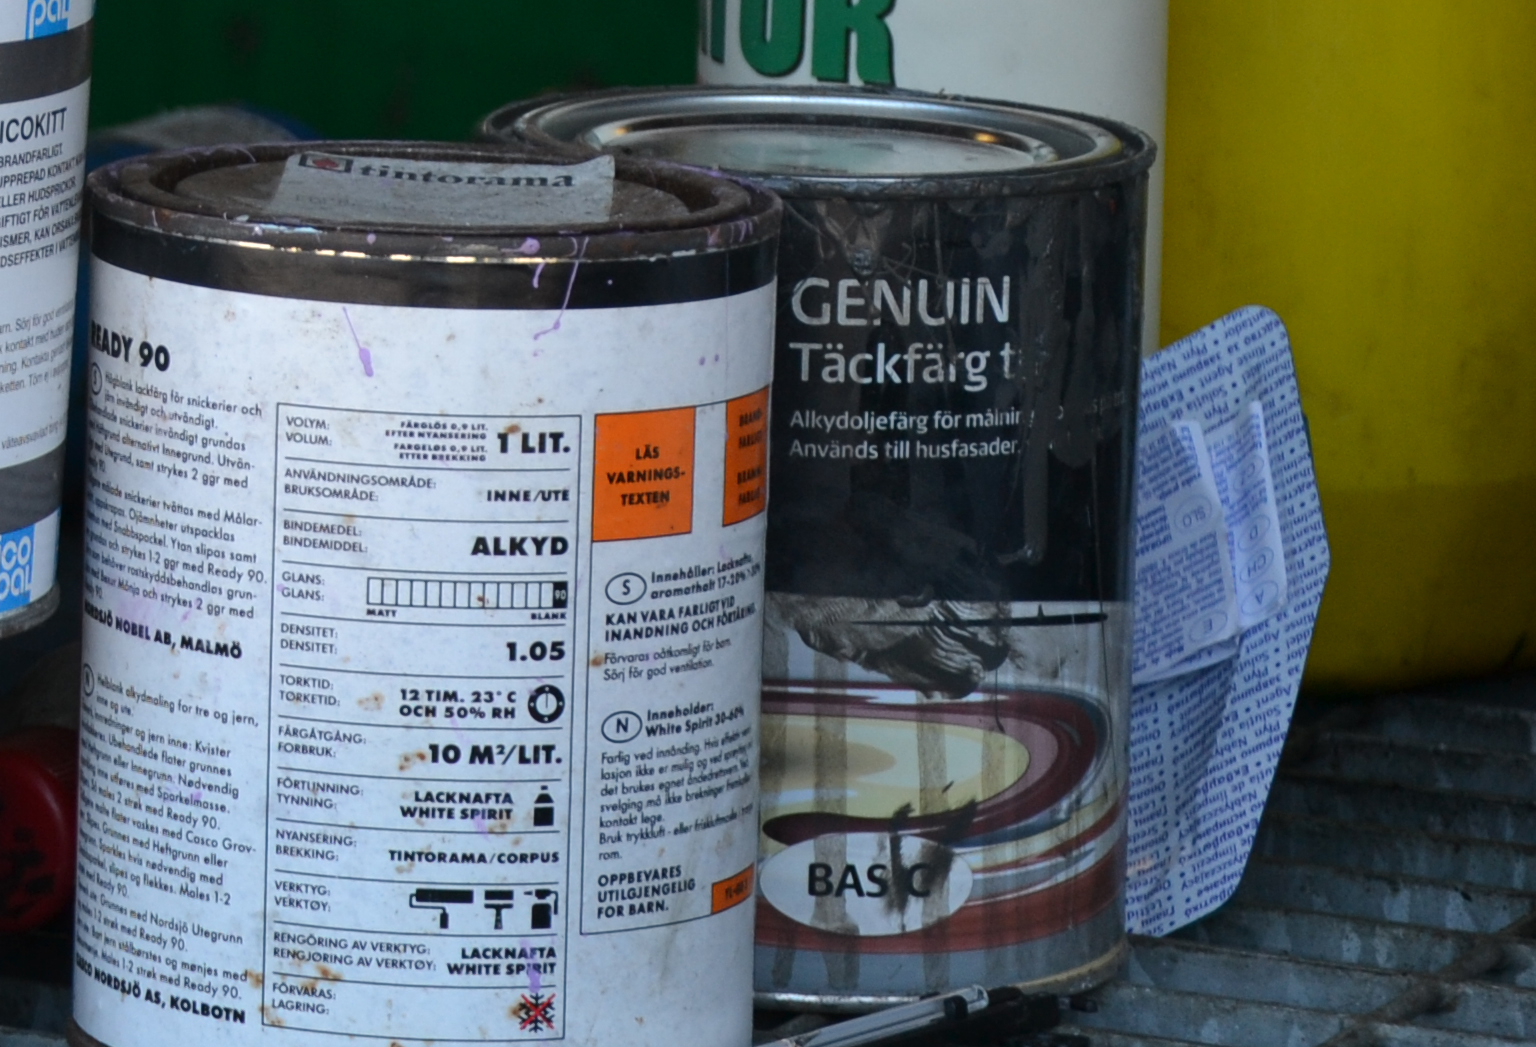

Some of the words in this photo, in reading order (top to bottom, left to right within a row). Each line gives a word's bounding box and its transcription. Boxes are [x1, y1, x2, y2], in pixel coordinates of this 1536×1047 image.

[0, 107, 67, 144] ICOKITT
[359, 165, 575, 188] tintorama
[791, 275, 1011, 327] GENUIN
[139, 341, 171, 372] 90
[789, 342, 991, 392] Täckfärg
[241, 403, 262, 416] och
[286, 416, 330, 430] VOLYM:
[789, 410, 929, 434] Alkydoljefärg
[933, 410, 962, 429] för
[285, 432, 332, 446] VOLUM:
[521, 432, 571, 454] LIT.
[789, 439, 879, 460] Används
[884, 441, 911, 459] till
[915, 437, 1021, 459] husfasader.
[635, 445, 660, 460] LÄS
[284, 468, 436, 490] ANVÄNDNINGSOMRÅDE:
[606, 466, 686, 485] VARNINGS-
[284, 483, 379, 502] BRUKSOMRÅDE:
[486, 489, 570, 502] INNE/UTE
[620, 490, 670, 506] TEXTEN
[283, 520, 362, 537] BINDEMEDEL:
[283, 535, 368, 553] BINDEMIDDEL:
[470, 536, 569, 556] ALKYD
[282, 572, 325, 585] GLANS:
[605, 613, 637, 626] KAN
[640, 607, 675, 622] VARA
[116, 617, 151, 640] NOBEL
[154, 630, 177, 649] AB,
[180, 635, 242, 659] MALMÖ
[280, 623, 338, 638] DENSITET:
[605, 620, 689, 642] INANDNING
[506, 641, 566, 662] 1.05
[280, 674, 334, 690] TORKTID:
[400, 688, 420, 701] 12
[426, 690, 466, 703] TIM.
[507, 691, 516, 703] C
[399, 705, 438, 718] OCH
[444, 706, 486, 719] 50%
[492, 706, 516, 719] RH
[429, 744, 461, 764] 10
[414, 791, 514, 804] LACKNAFTA
[400, 806, 455, 820] WHITE
[460, 808, 513, 820] SPIRIT
[388, 850, 560, 864] TINTORAMA/CORPUS
[597, 864, 682, 887] OPPBEVARES
[597, 878, 696, 903] UTILGJENGELIG
[597, 906, 624, 919] FOR
[351, 940, 372, 951] AV
[94, 966, 141, 998] NORDSJÖ
[145, 989, 166, 1009] AS,
[170, 995, 245, 1023] KOLBOTN
